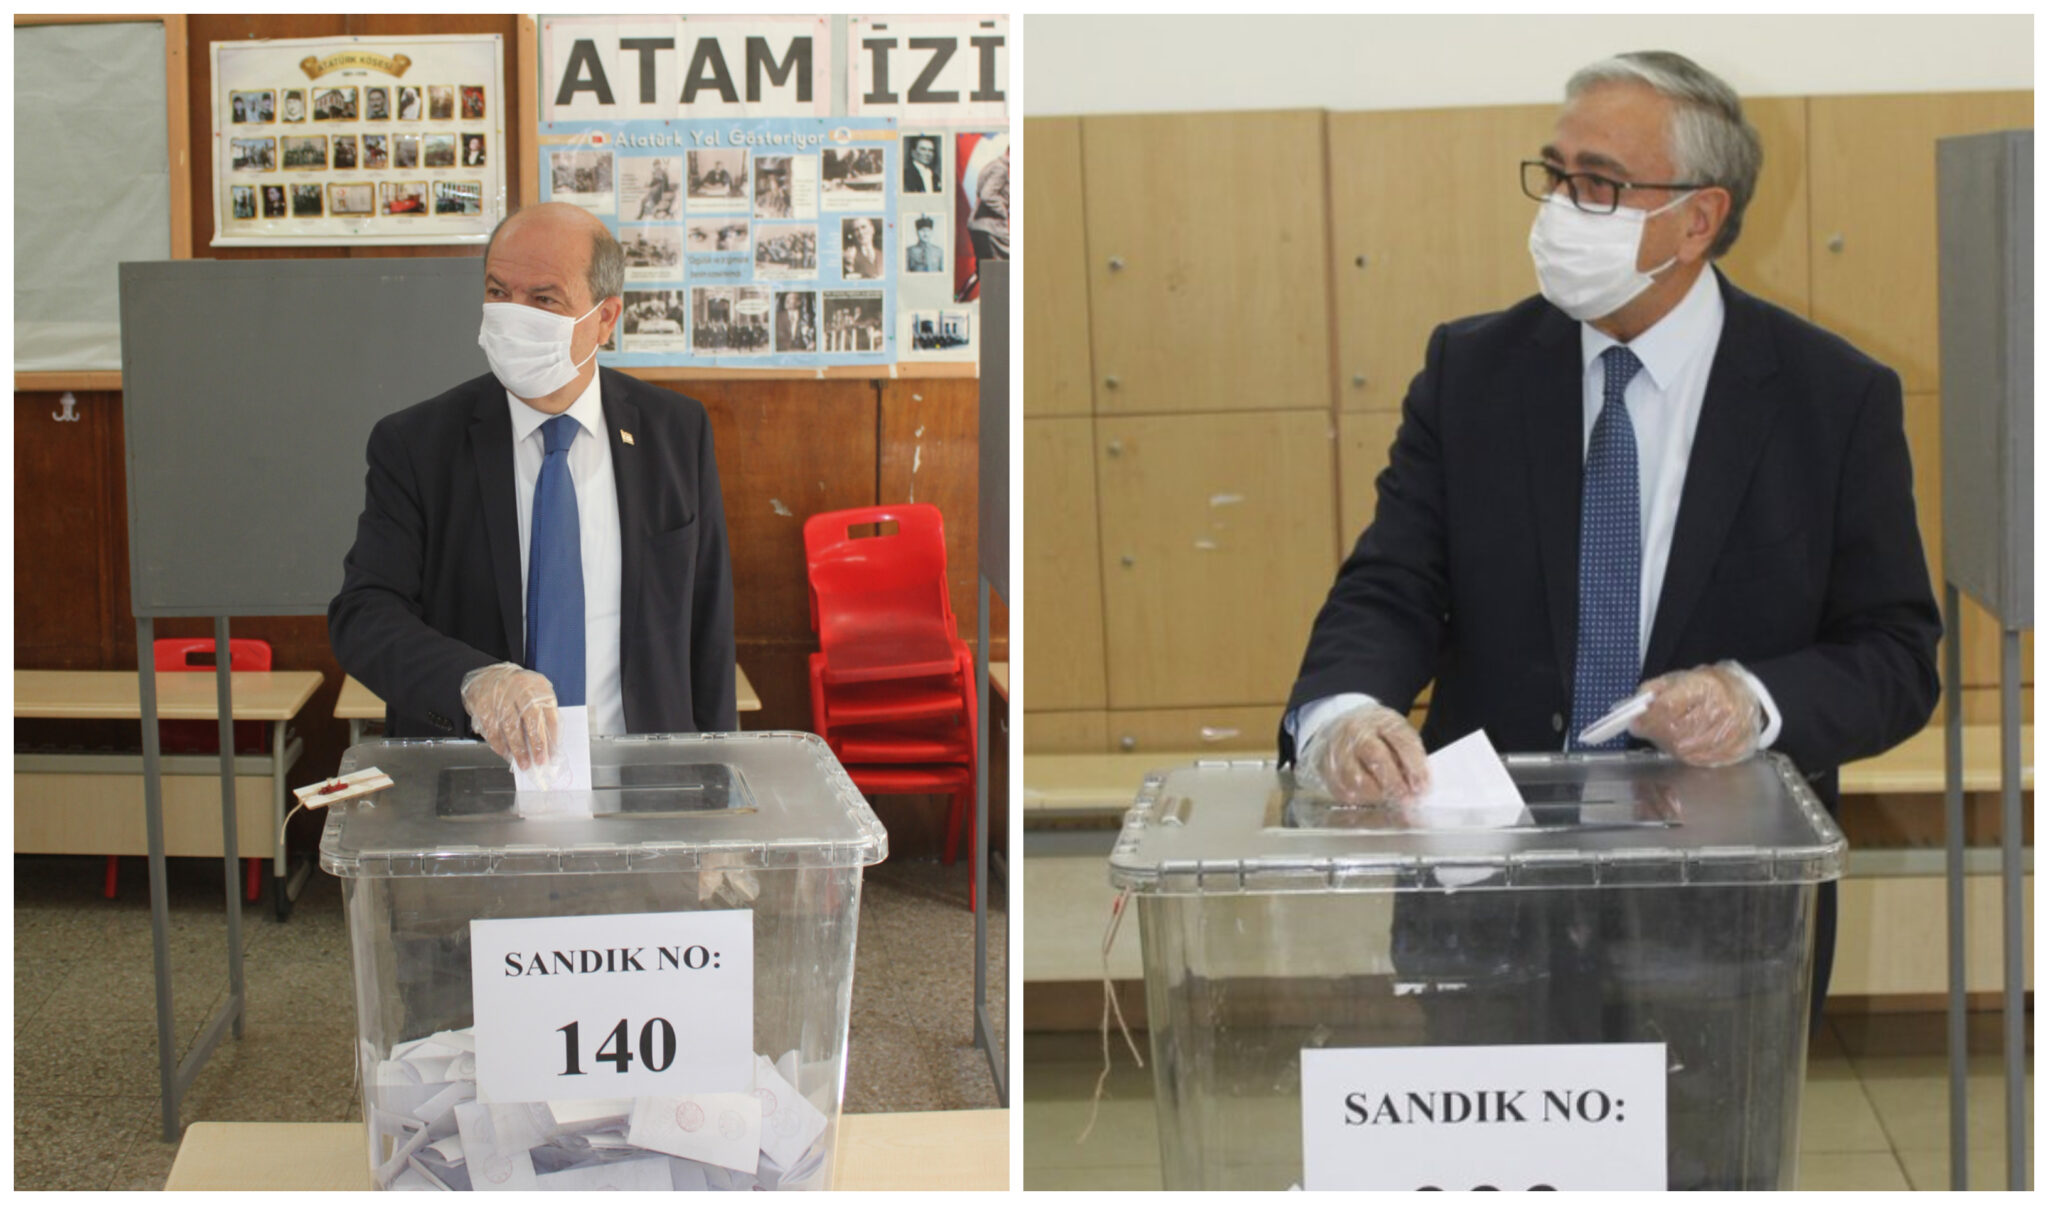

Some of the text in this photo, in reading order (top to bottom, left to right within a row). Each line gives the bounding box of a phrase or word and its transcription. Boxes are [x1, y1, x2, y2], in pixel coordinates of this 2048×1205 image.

[555, 21, 1005, 105] ATAM İZİ
[613, 129, 825, 151] Atatürk Yol Gösteriyor
[505, 945, 721, 977] SANDIK NO:
[556, 1017, 677, 1076] 140
[1344, 1089, 1626, 1126] SANDIK NO:
